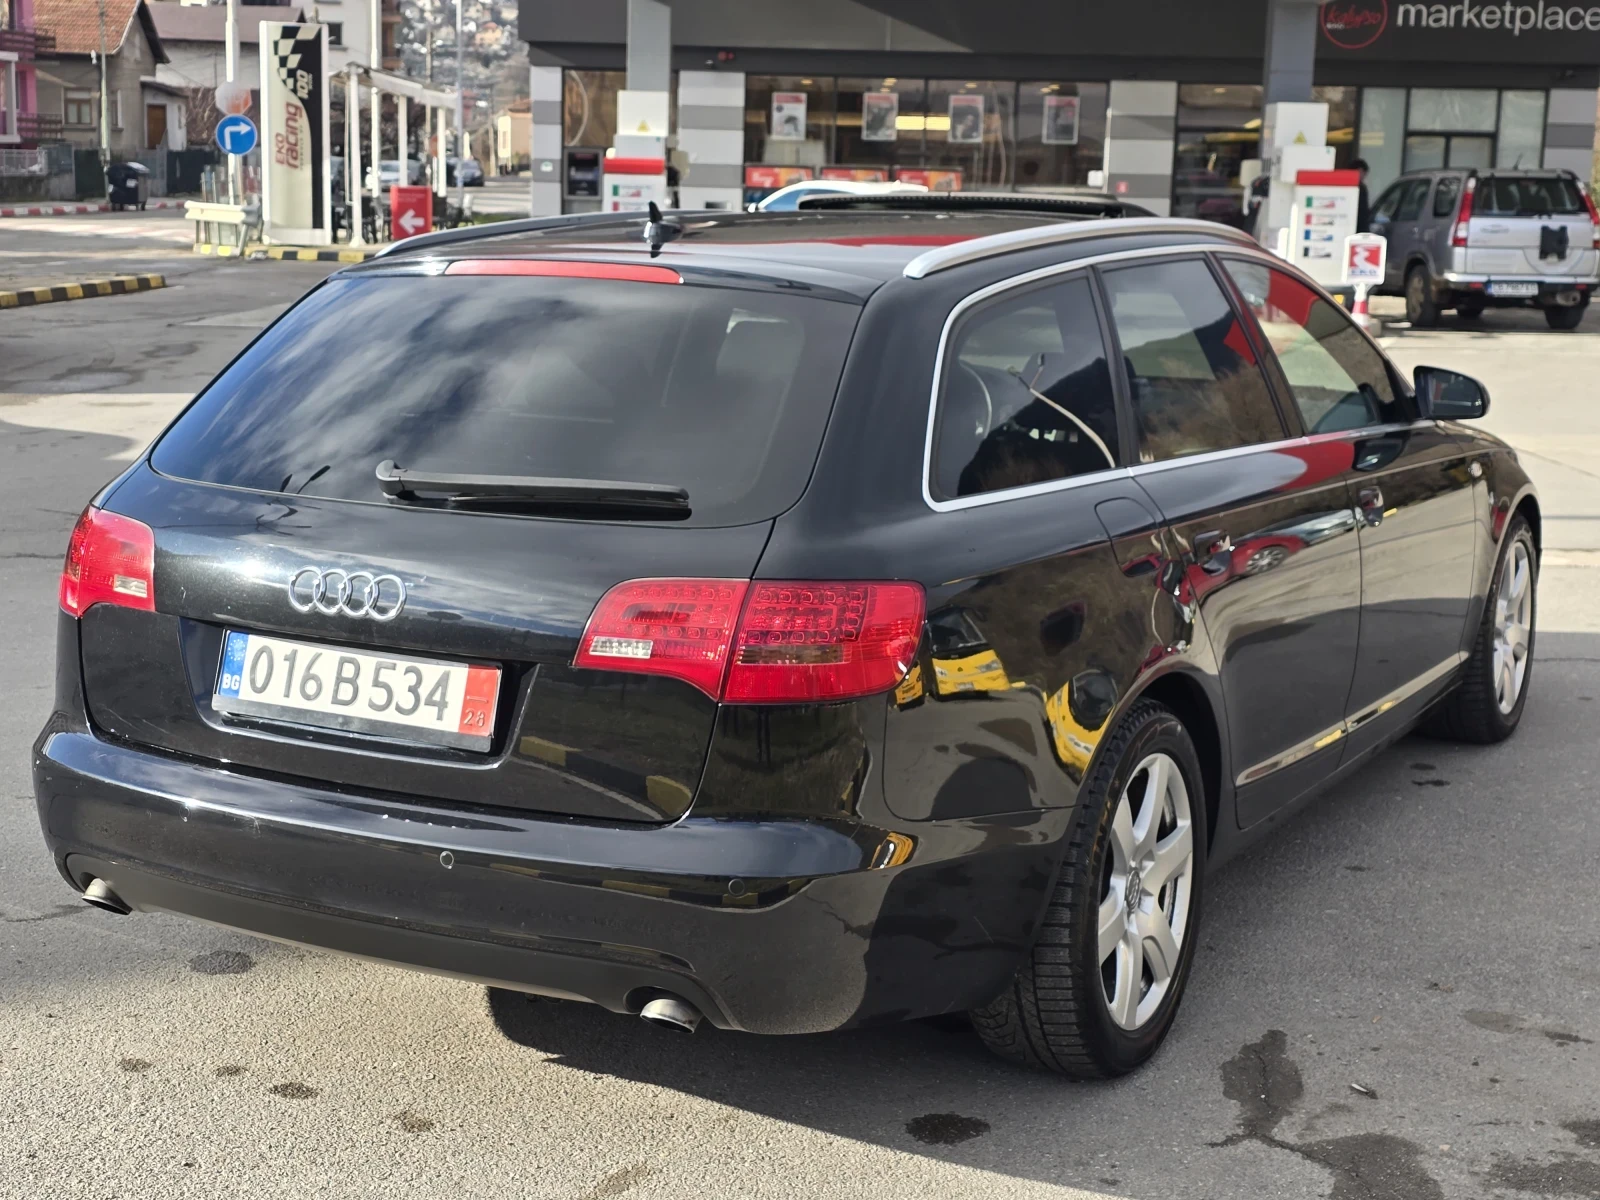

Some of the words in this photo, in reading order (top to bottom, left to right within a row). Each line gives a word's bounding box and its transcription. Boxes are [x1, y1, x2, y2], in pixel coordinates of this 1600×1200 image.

[1397, 0, 1600, 36] marketplace
[275, 132, 286, 165] EKO
[285, 101, 303, 169] racing
[222, 673, 240, 690] BG
[463, 708, 486, 728] 28
